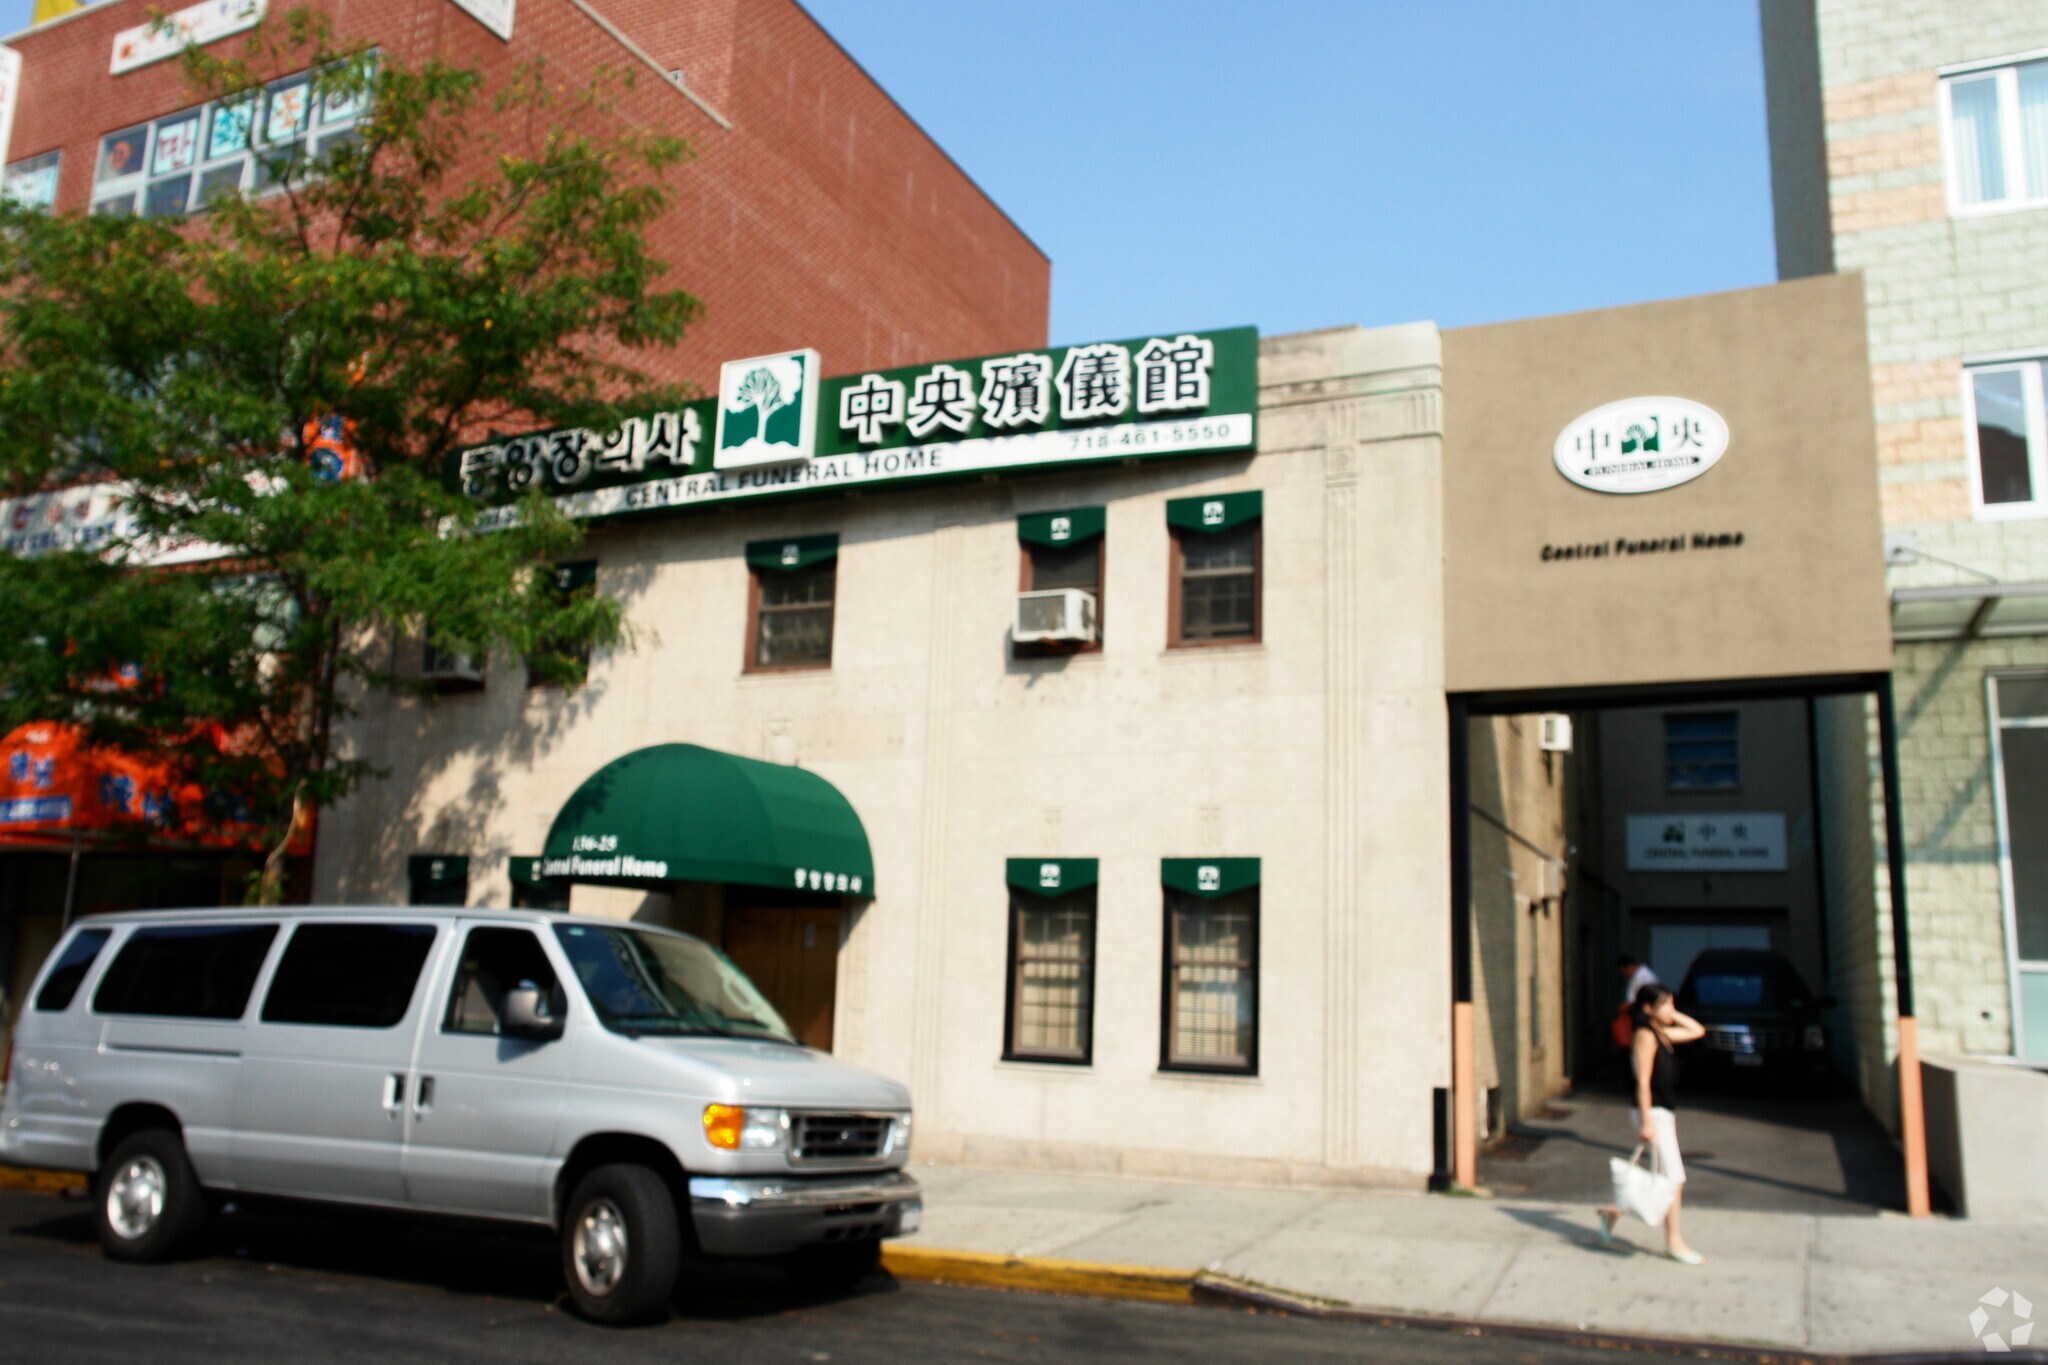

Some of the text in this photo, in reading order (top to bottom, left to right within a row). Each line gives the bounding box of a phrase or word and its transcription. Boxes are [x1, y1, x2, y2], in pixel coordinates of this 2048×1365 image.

[840, 335, 1213, 442] 中央殯儀館
[1071, 424, 1230, 449] 718-461-5550
[627, 448, 944, 507] CENTRAL FUNERAL HOME
[1541, 531, 1744, 562] Central Funeral Home
[571, 855, 621, 876] Funeral
[622, 856, 668, 879] Home
